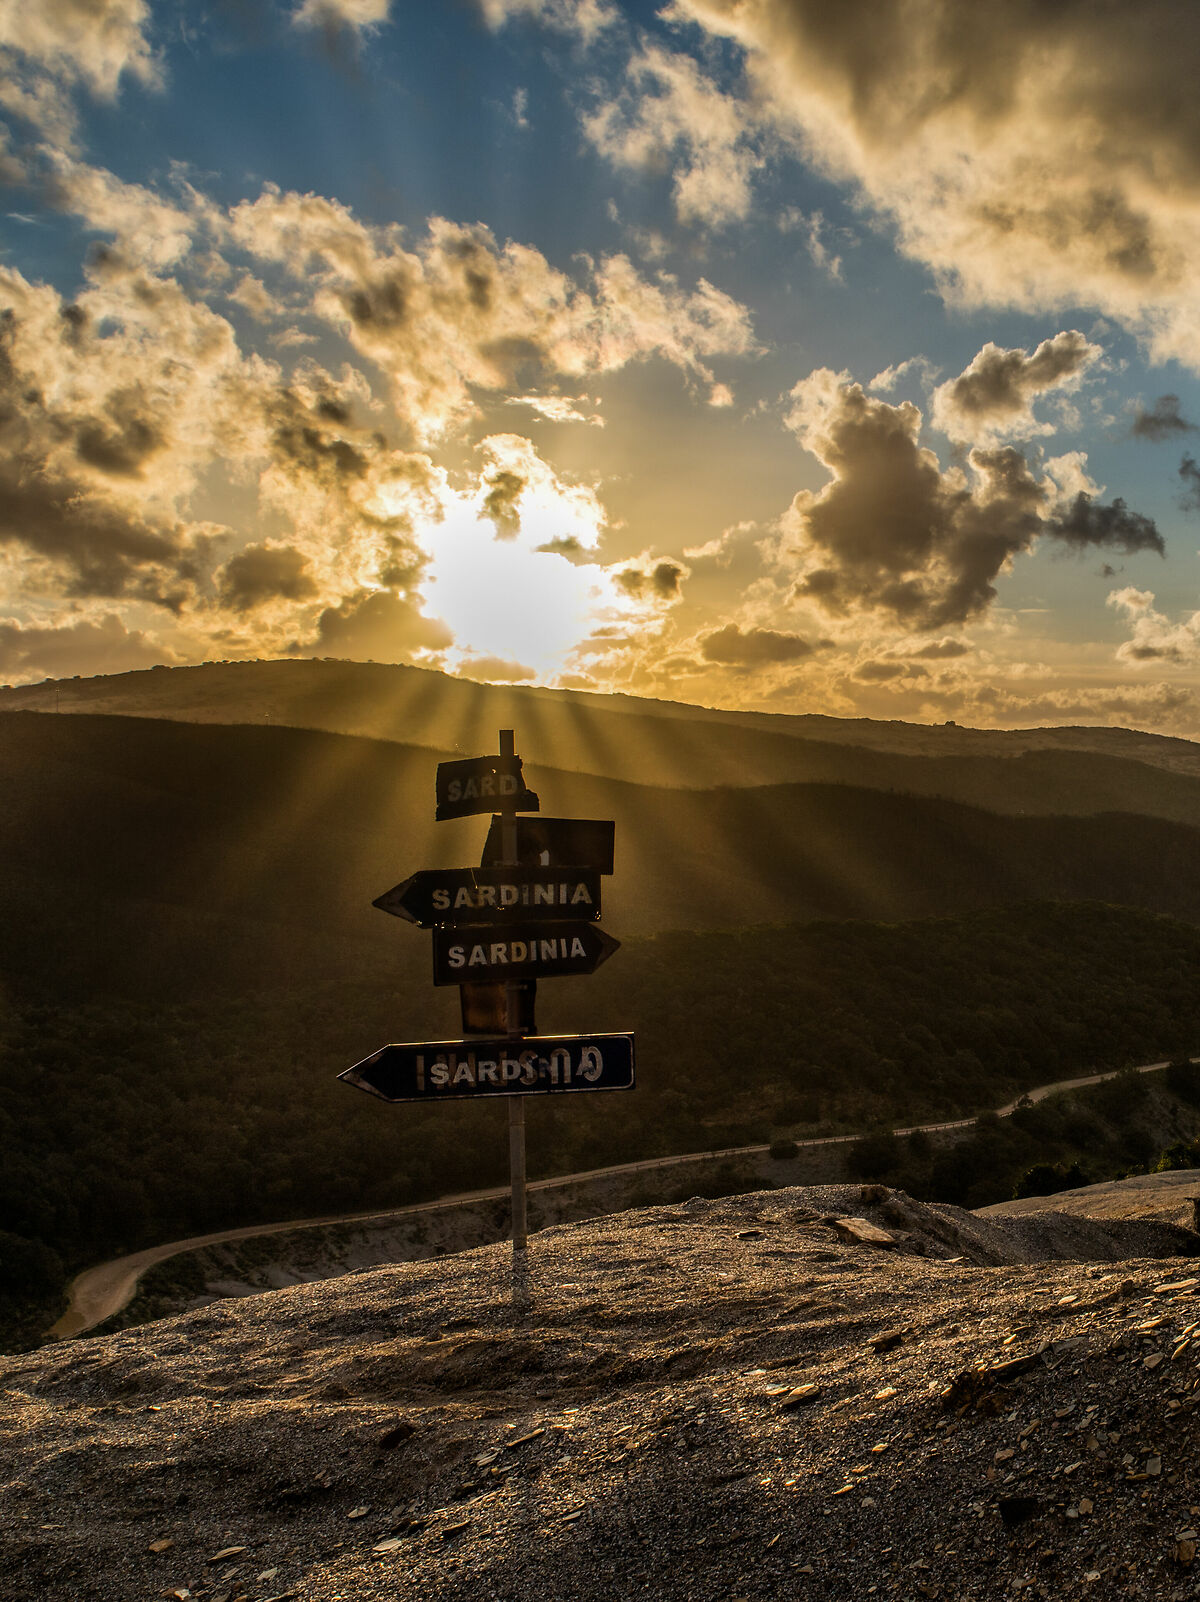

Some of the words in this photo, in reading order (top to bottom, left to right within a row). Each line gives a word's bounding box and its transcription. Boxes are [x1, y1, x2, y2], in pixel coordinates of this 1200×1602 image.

[447, 774, 518, 802] SARD
[431, 882, 592, 910] SARDINIA
[448, 937, 586, 968] SARDINIA
